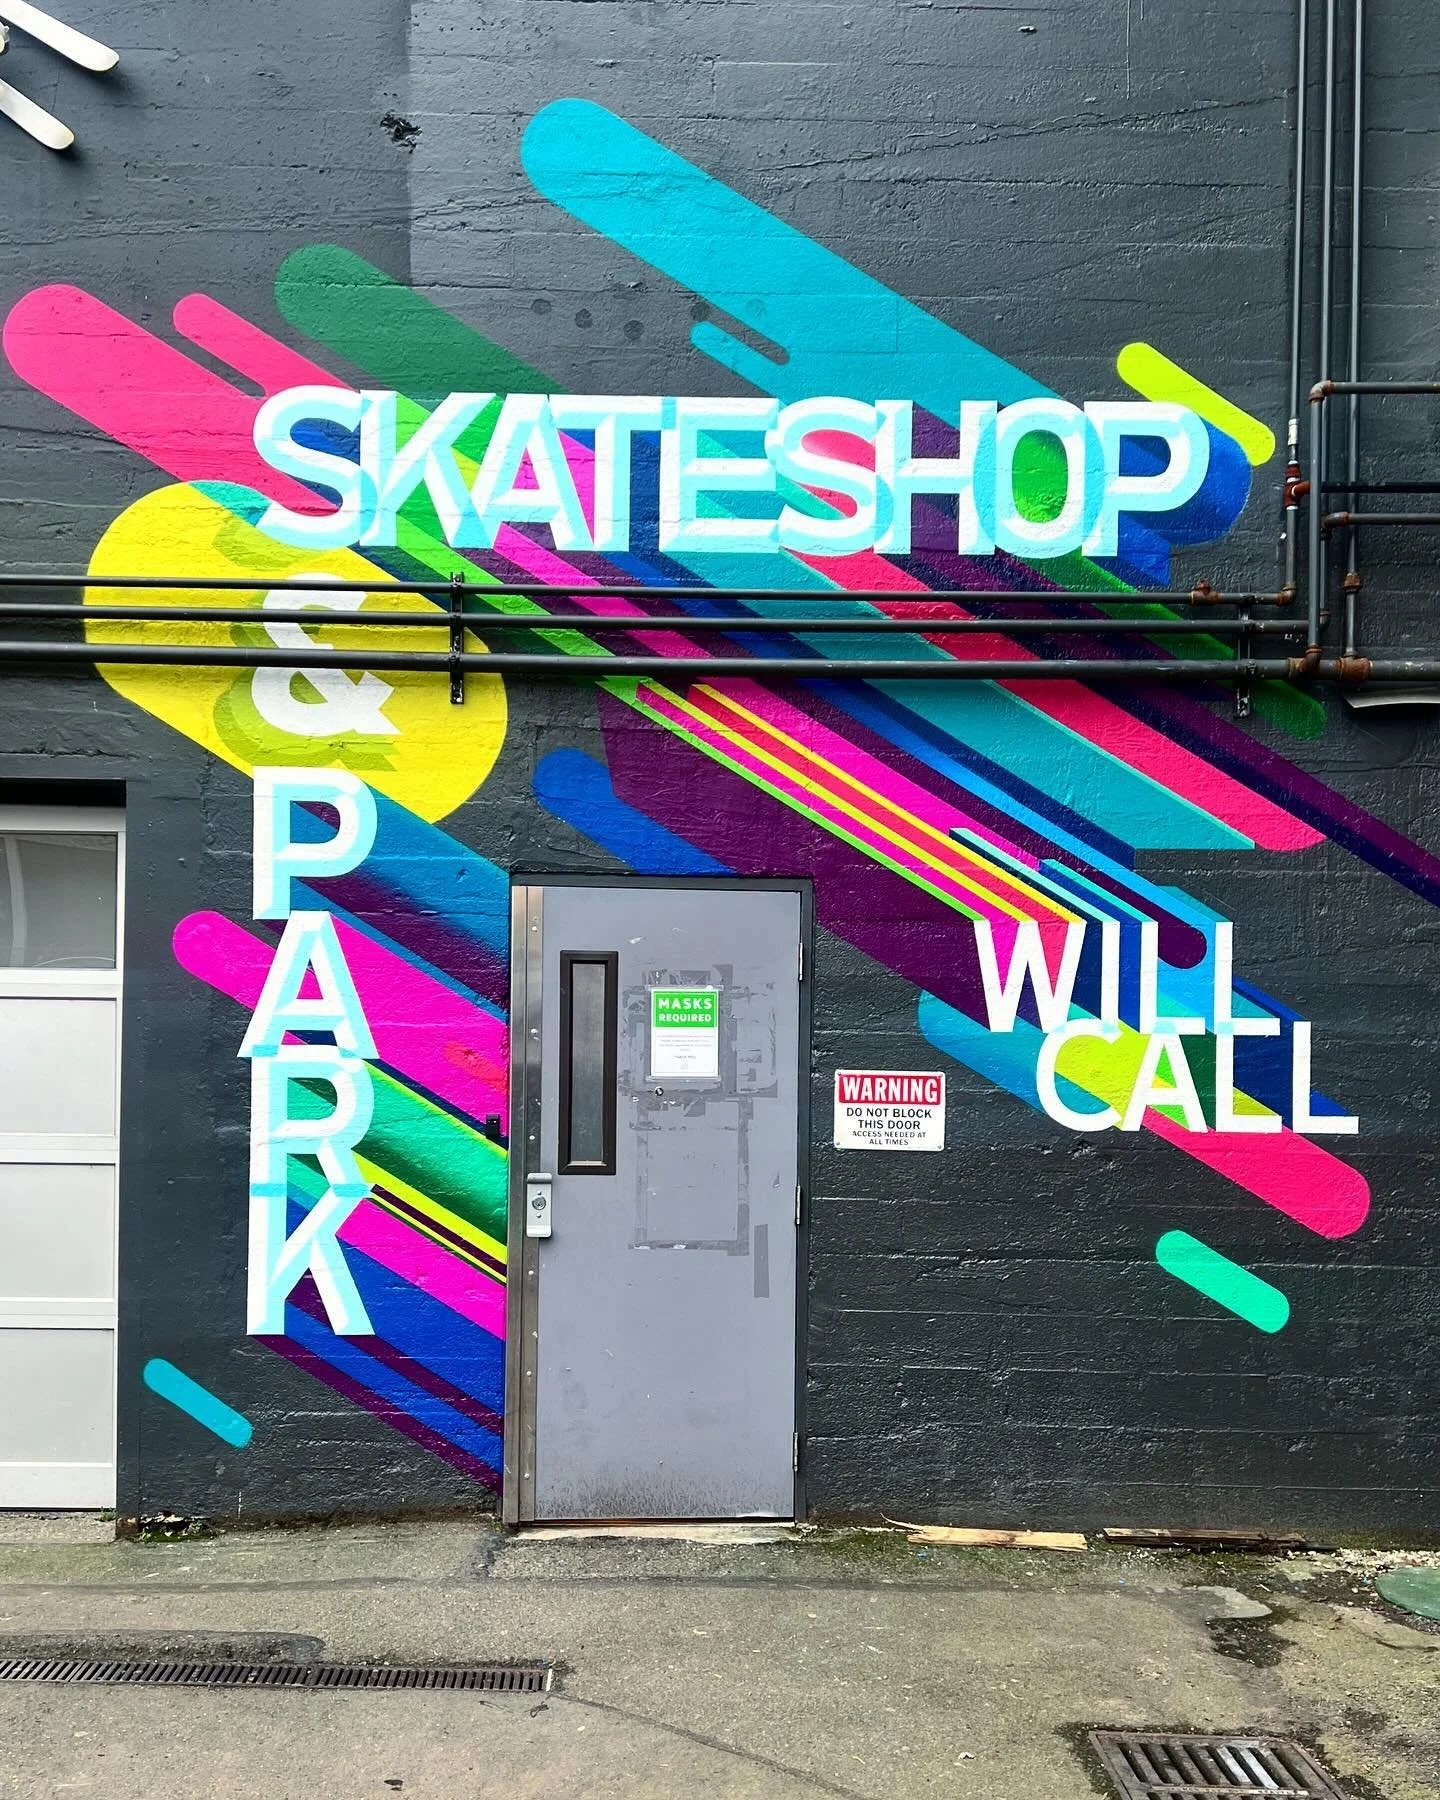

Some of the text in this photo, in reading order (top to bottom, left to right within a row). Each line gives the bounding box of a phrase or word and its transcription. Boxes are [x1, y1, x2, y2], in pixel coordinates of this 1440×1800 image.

[252, 386, 1209, 558] SKATESHOP
[251, 572, 400, 735] &
[973, 919, 1281, 1036] WILL
[658, 998, 712, 1009] MASKS
[658, 1013, 712, 1023] REQUIRED
[237, 766, 378, 1335] PARK
[843, 1076, 938, 1103] WARNING
[1036, 1018, 1360, 1135] CALL
[846, 1107, 932, 1118] DO NOT BLOCK
[858, 1119, 921, 1130] THIS DOOR
[885, 1138, 909, 1146] TIMES
